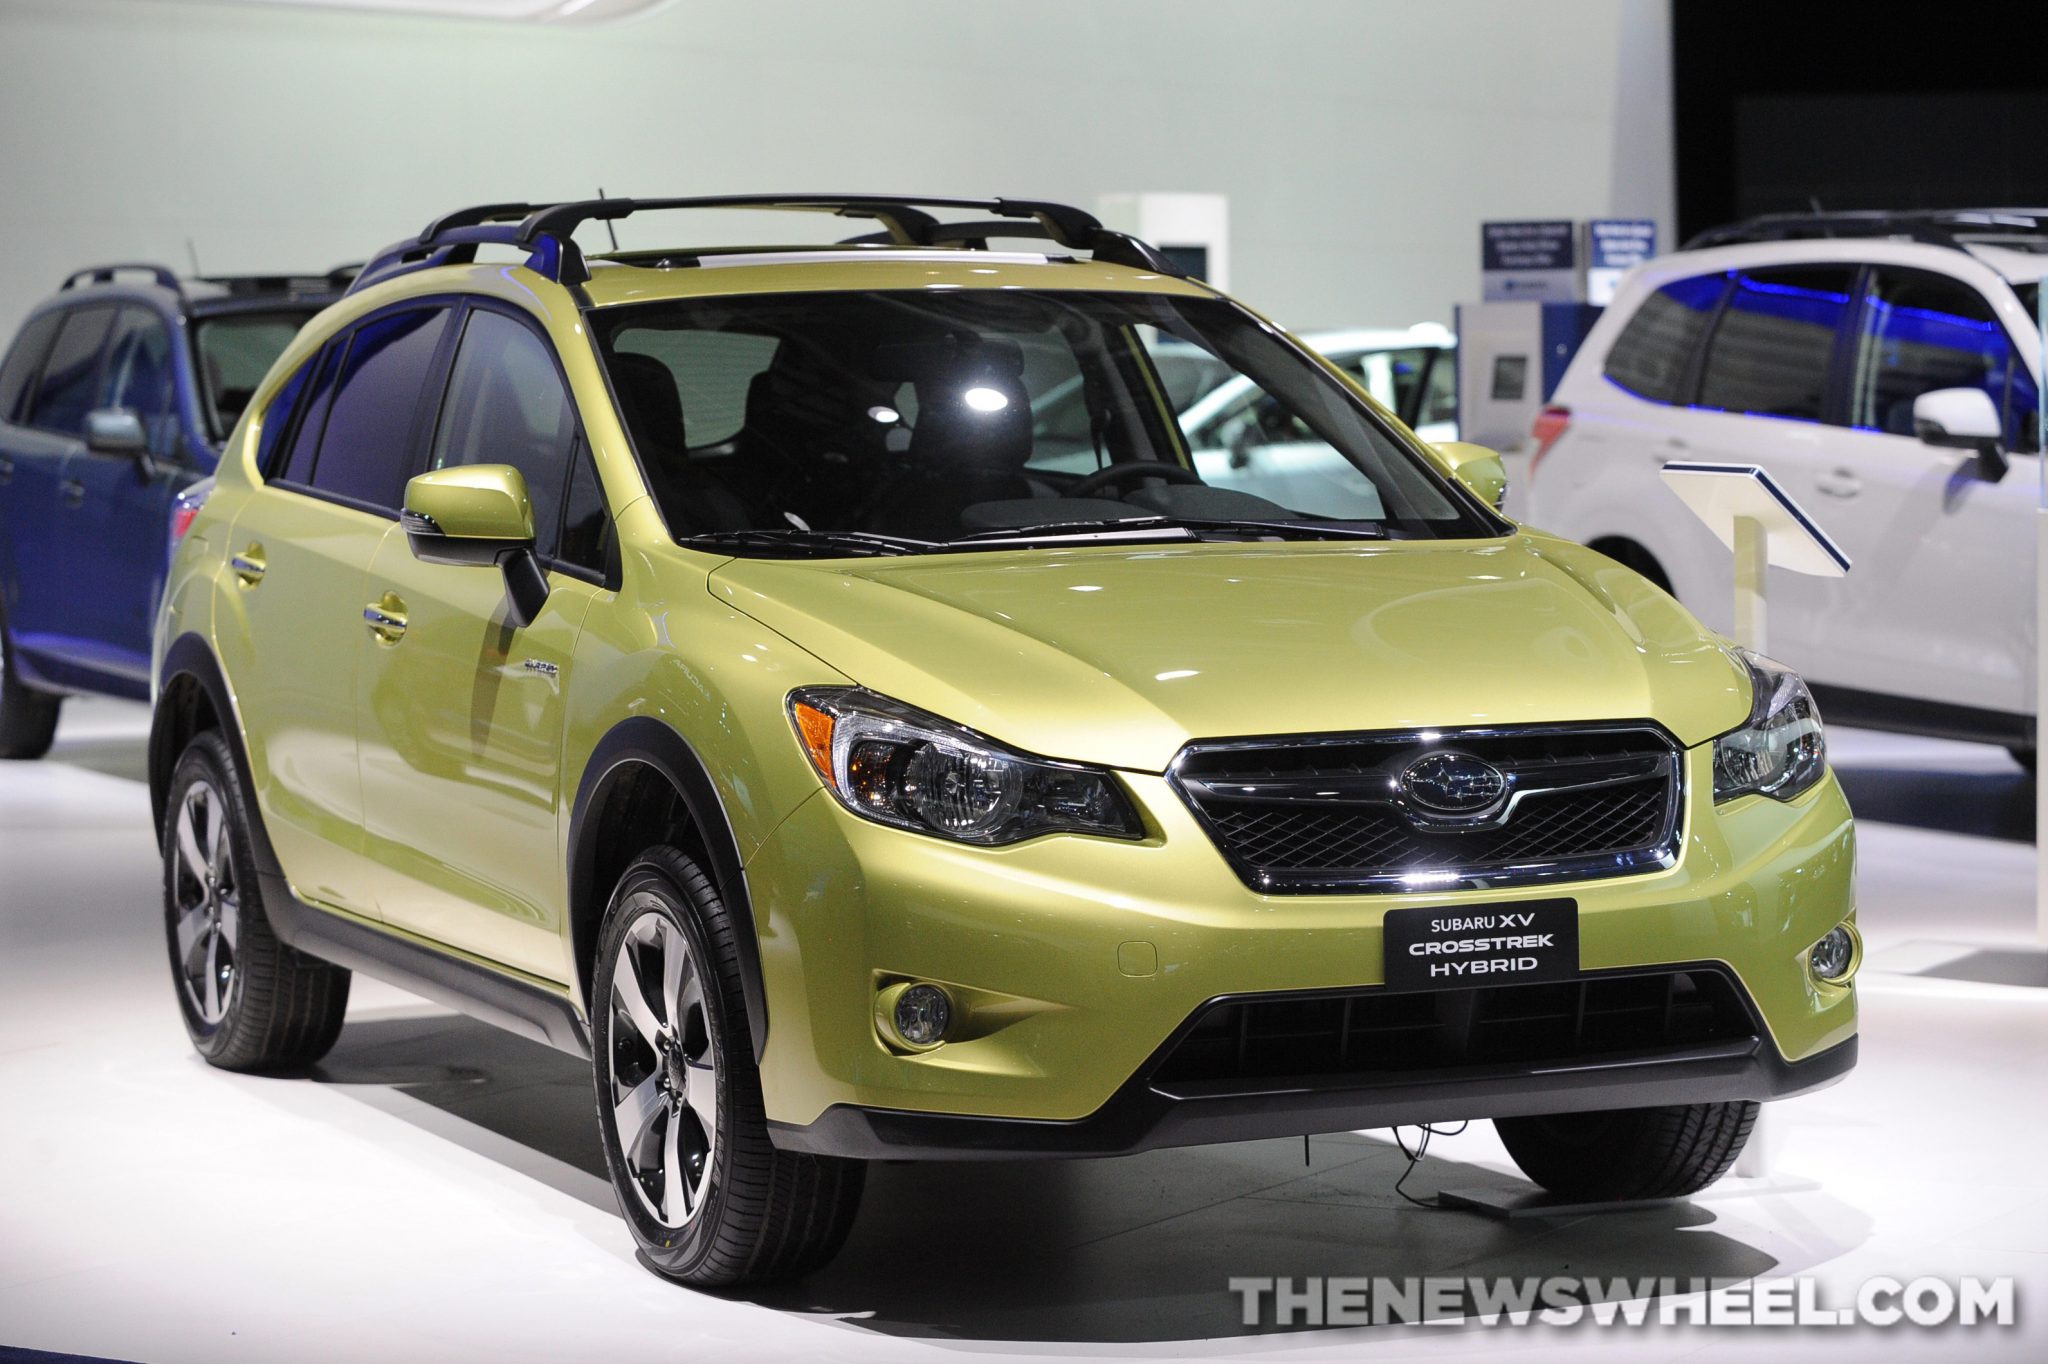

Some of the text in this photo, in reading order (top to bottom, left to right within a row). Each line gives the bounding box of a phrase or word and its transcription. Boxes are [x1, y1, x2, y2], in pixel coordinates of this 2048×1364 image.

[1431, 912, 1536, 933] SUBARU XV
[1408, 933, 1554, 956] CROSSTREK
[1430, 957, 1538, 977] HYBRID
